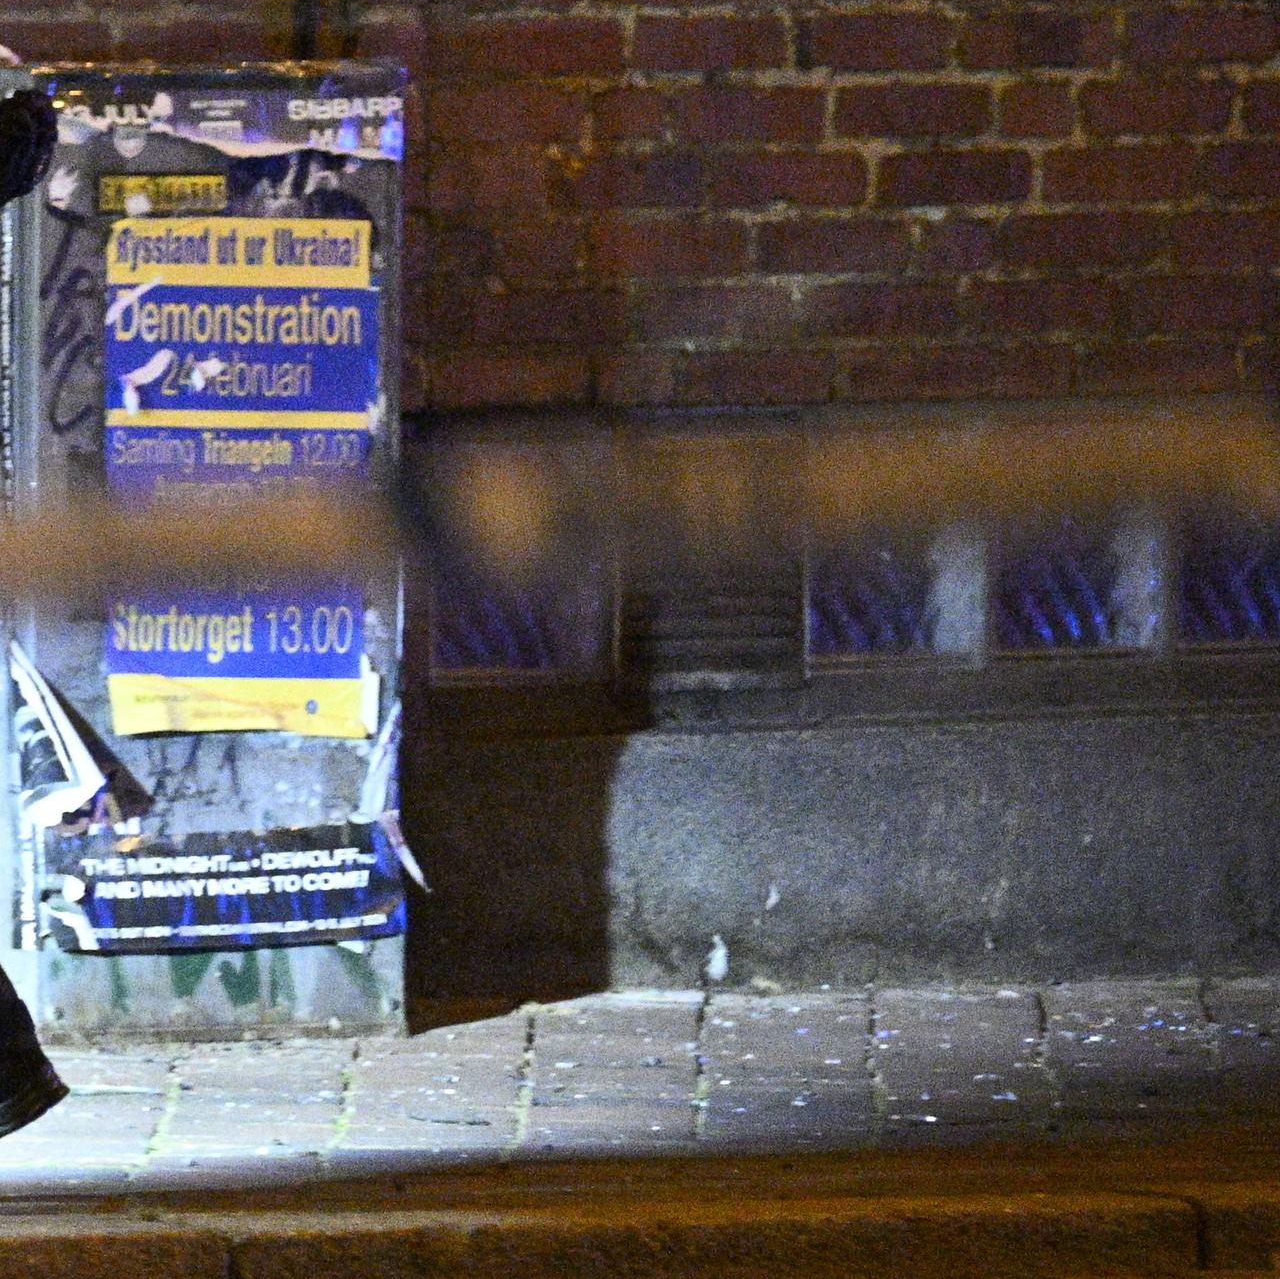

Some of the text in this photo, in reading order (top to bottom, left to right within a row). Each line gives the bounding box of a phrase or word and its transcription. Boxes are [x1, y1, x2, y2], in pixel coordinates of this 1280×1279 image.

[115, 227, 360, 271] Ryssland ut ur Ukraina!
[114, 290, 362, 346] Demonstration
[111, 602, 353, 664] Stortorget 13.00
[80, 857, 126, 876] THE
[126, 853, 232, 875] MIDNIGHT
[94, 880, 141, 899] AND
[142, 878, 207, 898] MANY
[207, 876, 270, 896] MORE
[271, 874, 301, 893] TO
